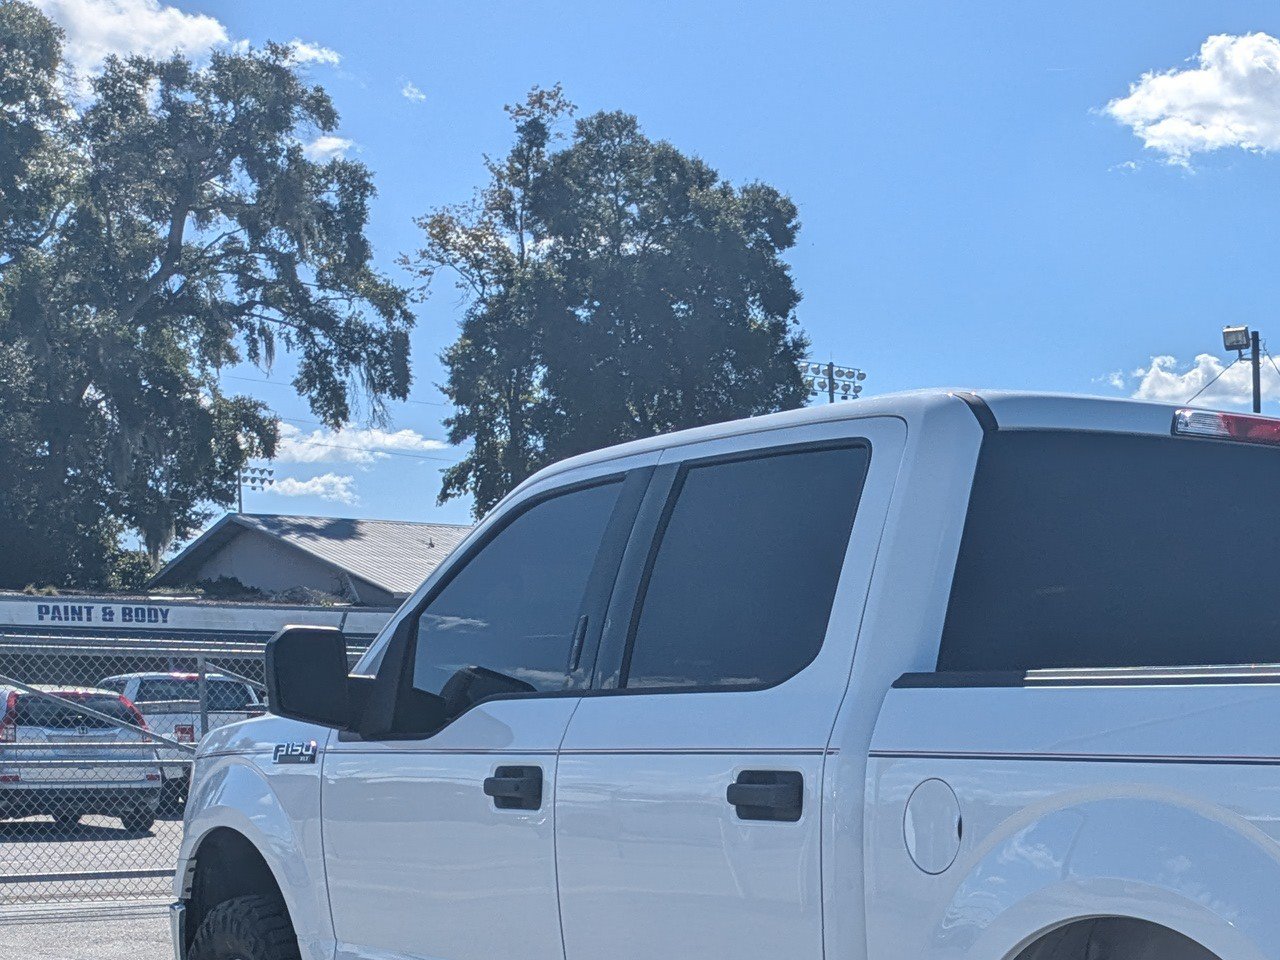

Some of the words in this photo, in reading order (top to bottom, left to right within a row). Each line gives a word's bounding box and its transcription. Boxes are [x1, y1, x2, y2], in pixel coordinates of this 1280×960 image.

[37, 604, 95, 622] PAINT
[102, 606, 115, 623] &
[121, 606, 170, 624] BODY
